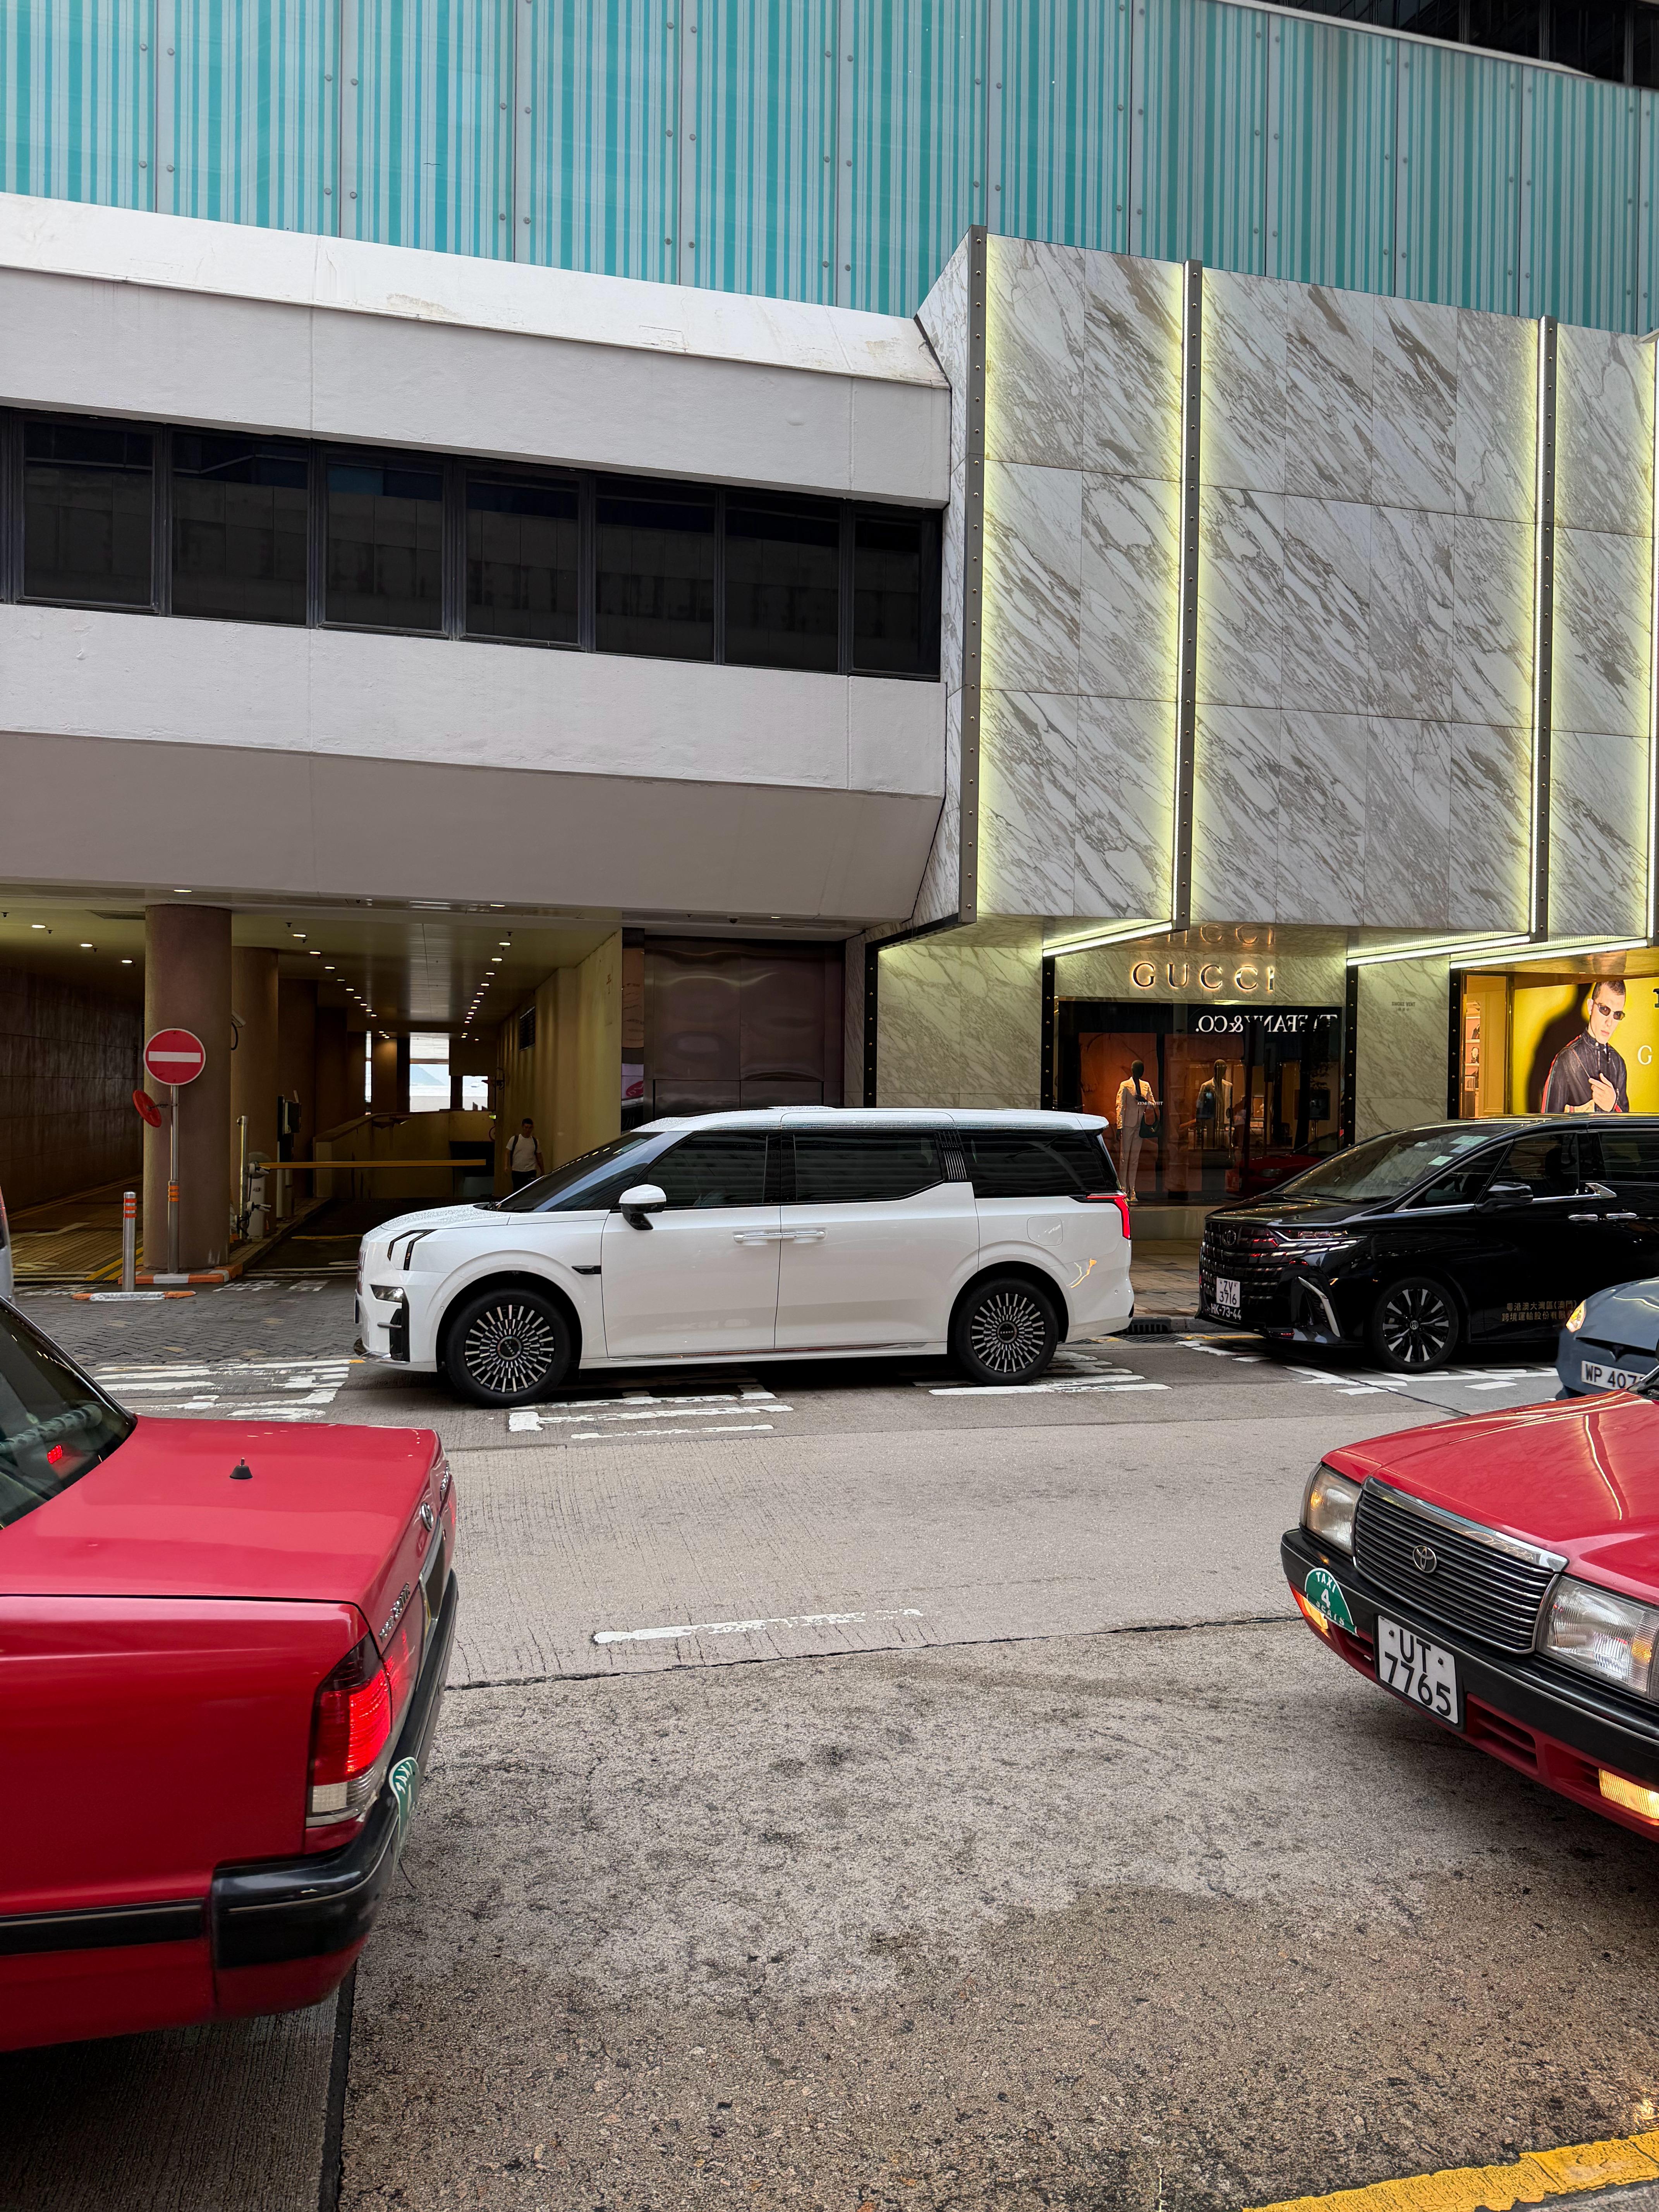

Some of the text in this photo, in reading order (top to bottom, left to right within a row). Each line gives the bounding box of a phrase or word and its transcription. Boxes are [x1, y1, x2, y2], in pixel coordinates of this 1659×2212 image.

[1132, 963, 1275, 990] GUCCI
[1224, 1280, 1233, 1293] ZY
[1219, 1291, 1237, 1305] 3716
[1211, 1303, 1242, 1320] HK-73-44
[1585, 1364, 1644, 1389] WP 407
[1316, 1572, 1336, 1593] TAXI
[1321, 1589, 1331, 1609] 4
[1400, 1628, 1431, 1673] UT
[1384, 1651, 1451, 1716] 7765
